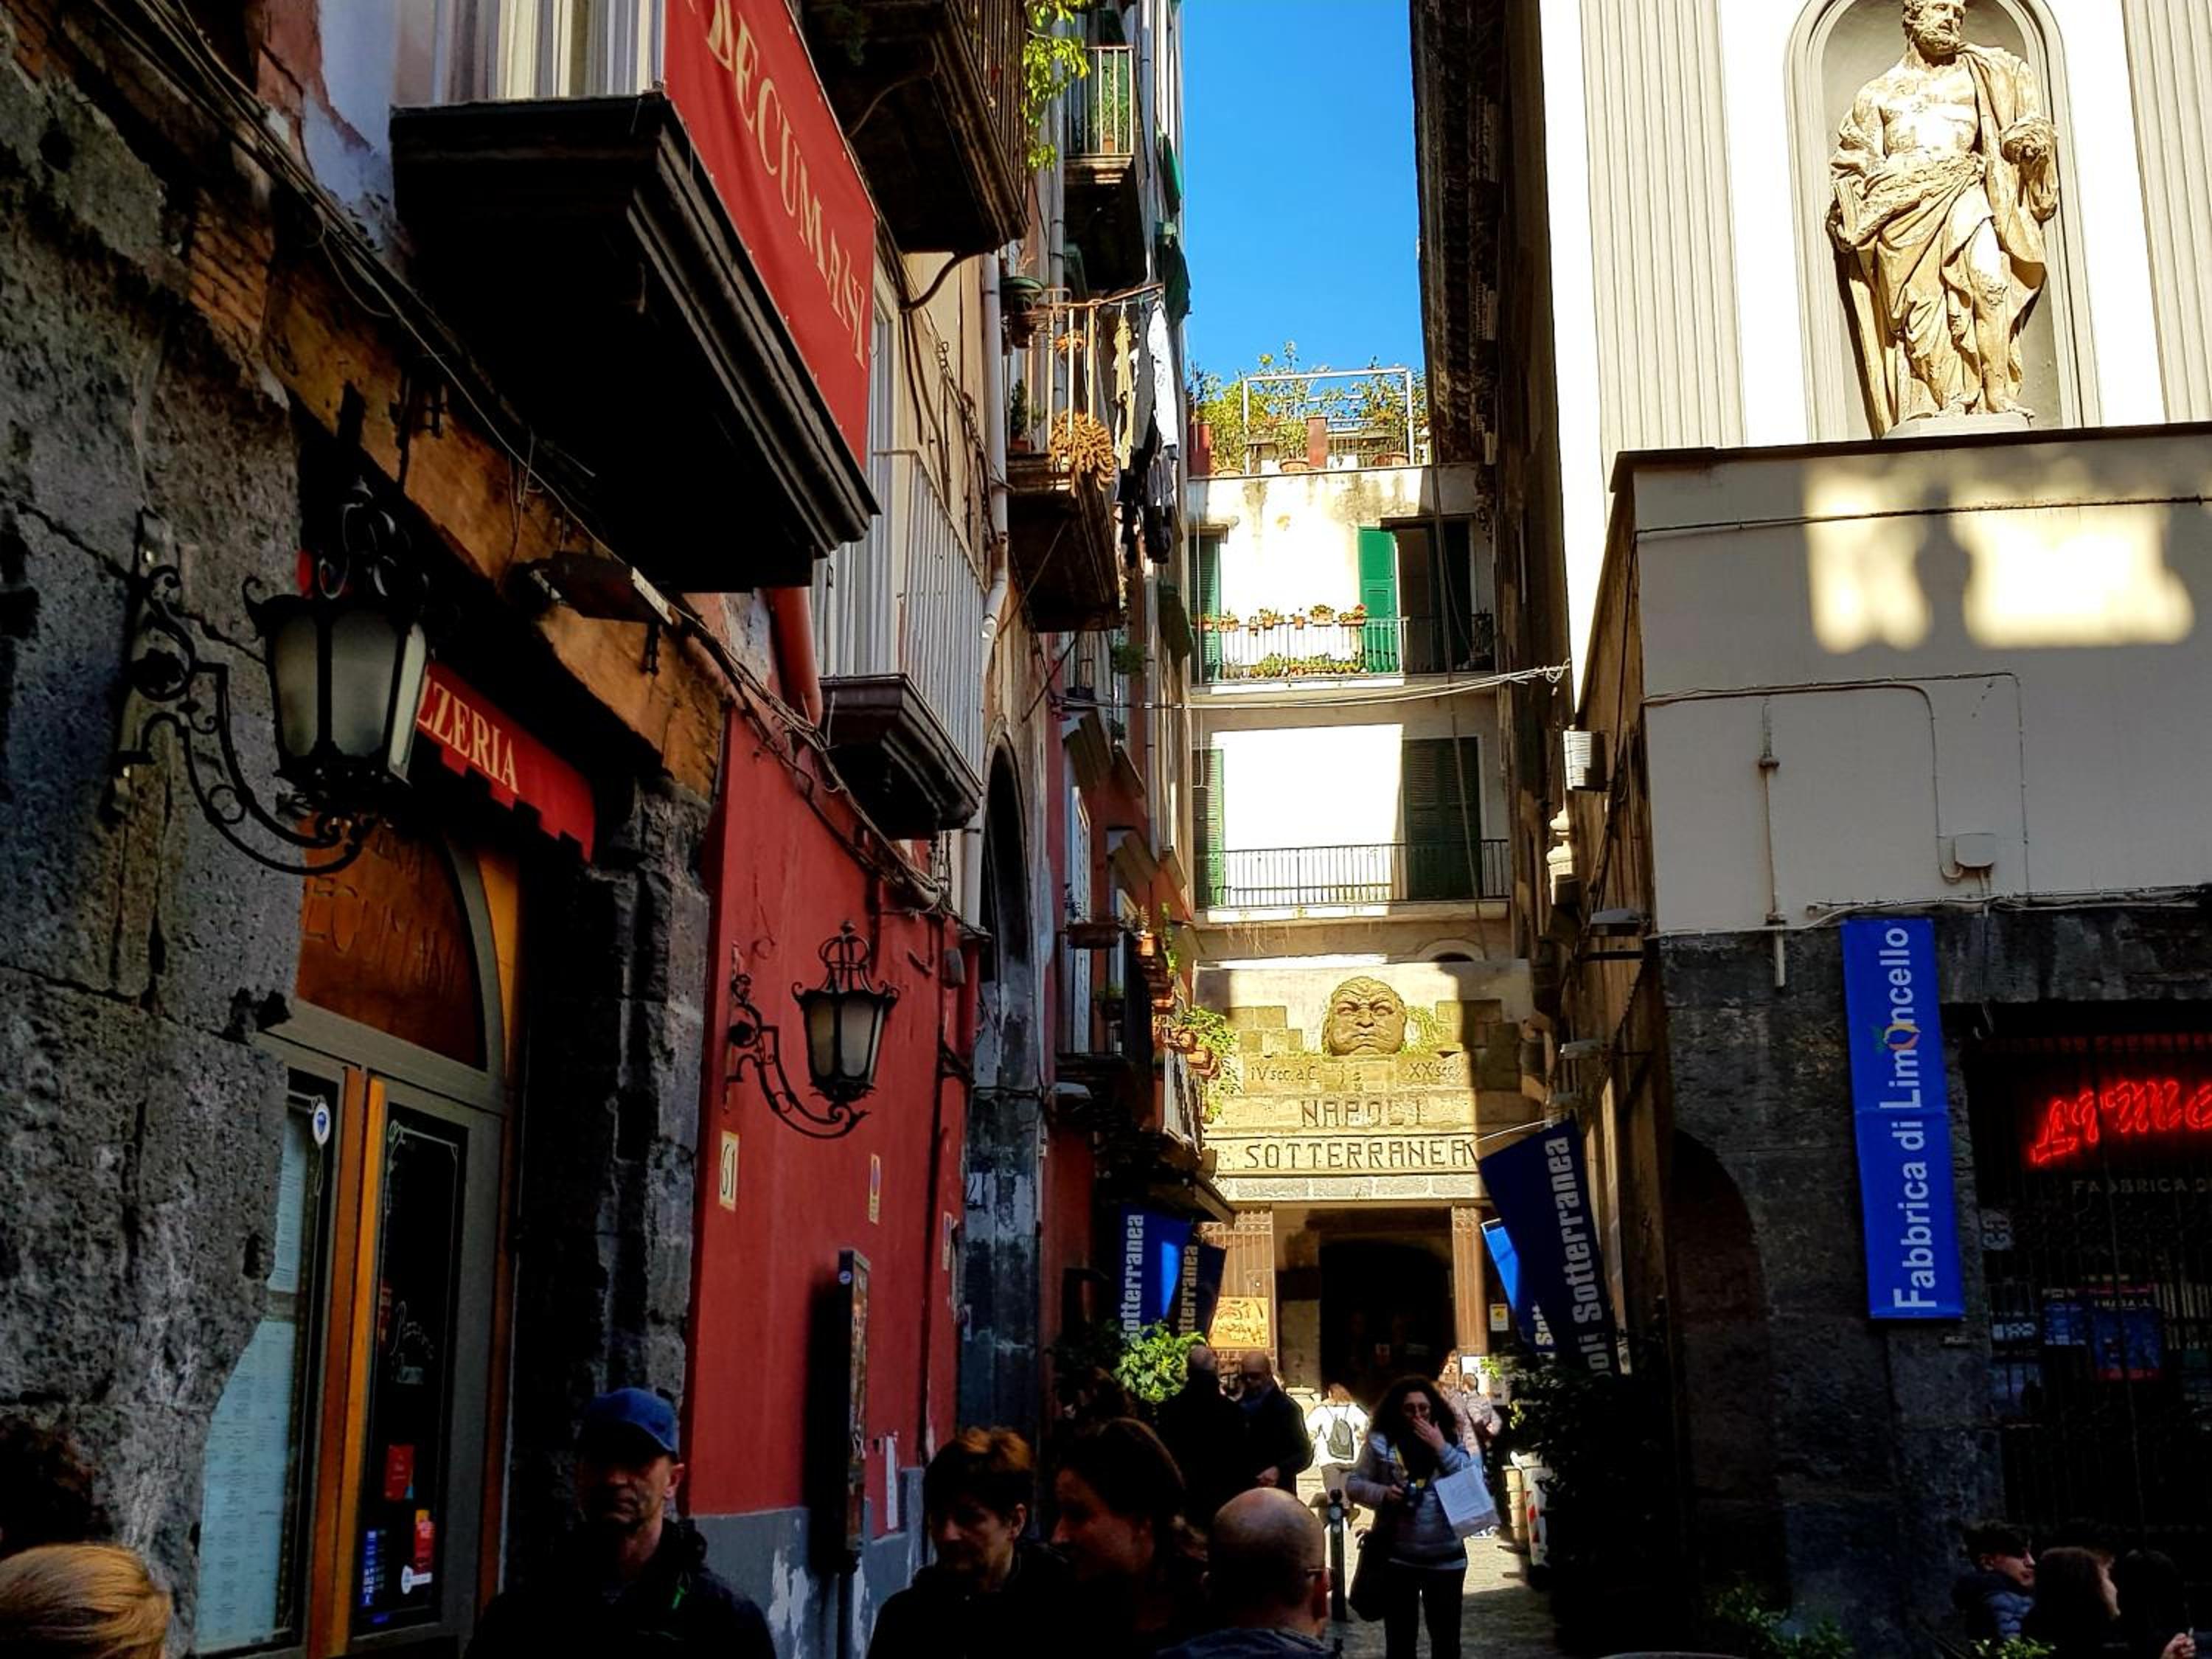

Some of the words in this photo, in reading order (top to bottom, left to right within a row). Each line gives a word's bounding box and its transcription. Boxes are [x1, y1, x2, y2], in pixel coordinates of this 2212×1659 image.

[1300, 1099, 1422, 1127] NAPOLI
[1891, 1120, 1924, 1152] di
[1244, 1140, 1469, 1169] SOTTERRANEA
[1544, 1136, 1602, 1325] Sotterranea
[1894, 1162, 1937, 1310] Fabbrica
